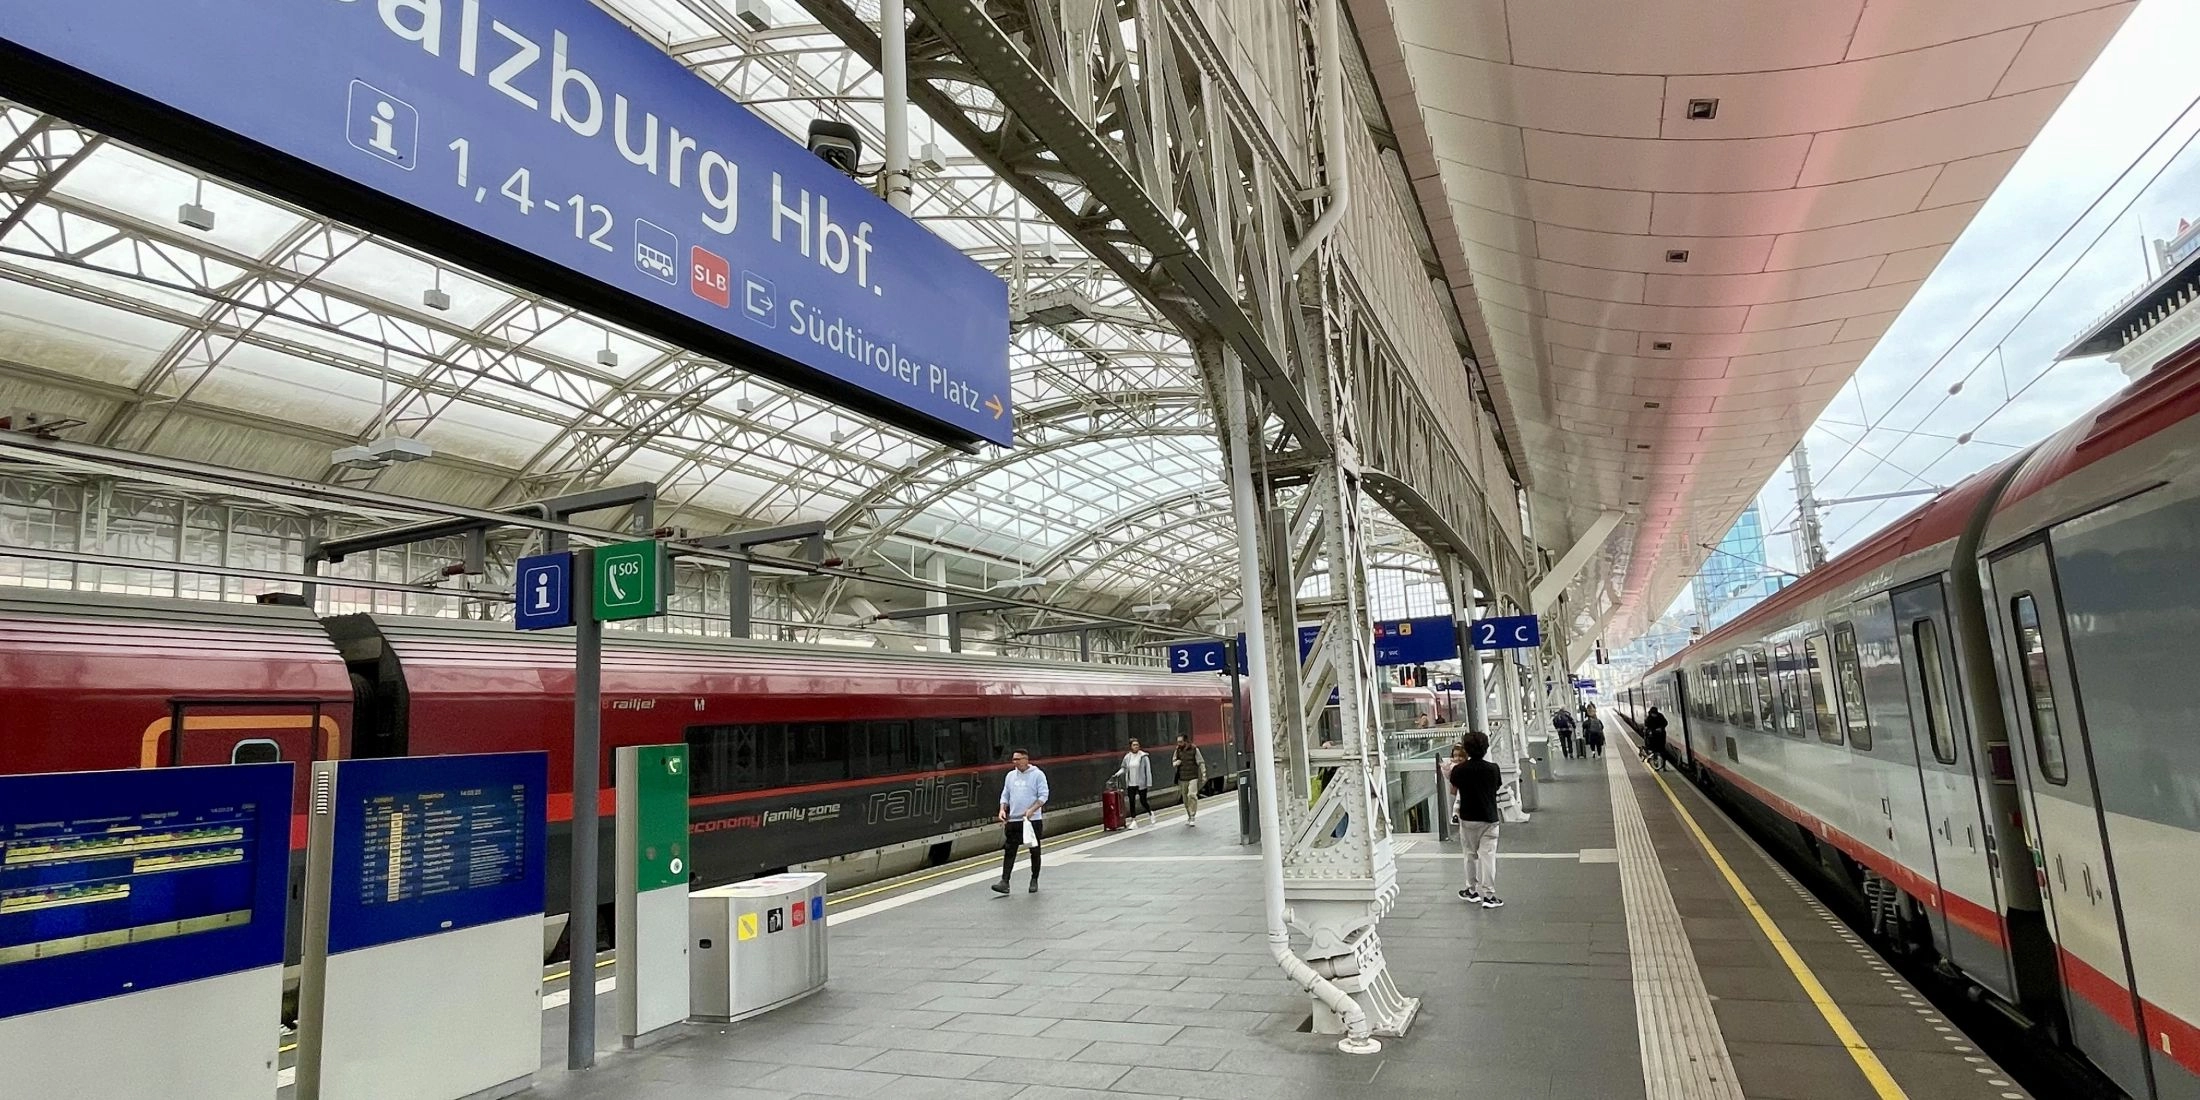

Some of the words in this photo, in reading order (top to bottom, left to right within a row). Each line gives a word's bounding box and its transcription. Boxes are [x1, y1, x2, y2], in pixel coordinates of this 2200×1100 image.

[333, 0, 739, 235] alzburg
[771, 170, 883, 297] Hbf.
[693, 263, 729, 293] SLB
[789, 299, 921, 387] Südtiroler
[929, 363, 981, 413] Platz
[618, 560, 639, 577] SOS
[1481, 623, 1497, 645] 2
[1177, 649, 1190, 668] 3
[612, 697, 656, 711] railjet
[867, 771, 982, 825] railjet
[762, 806, 806, 827] family
[808, 803, 841, 817] zone
